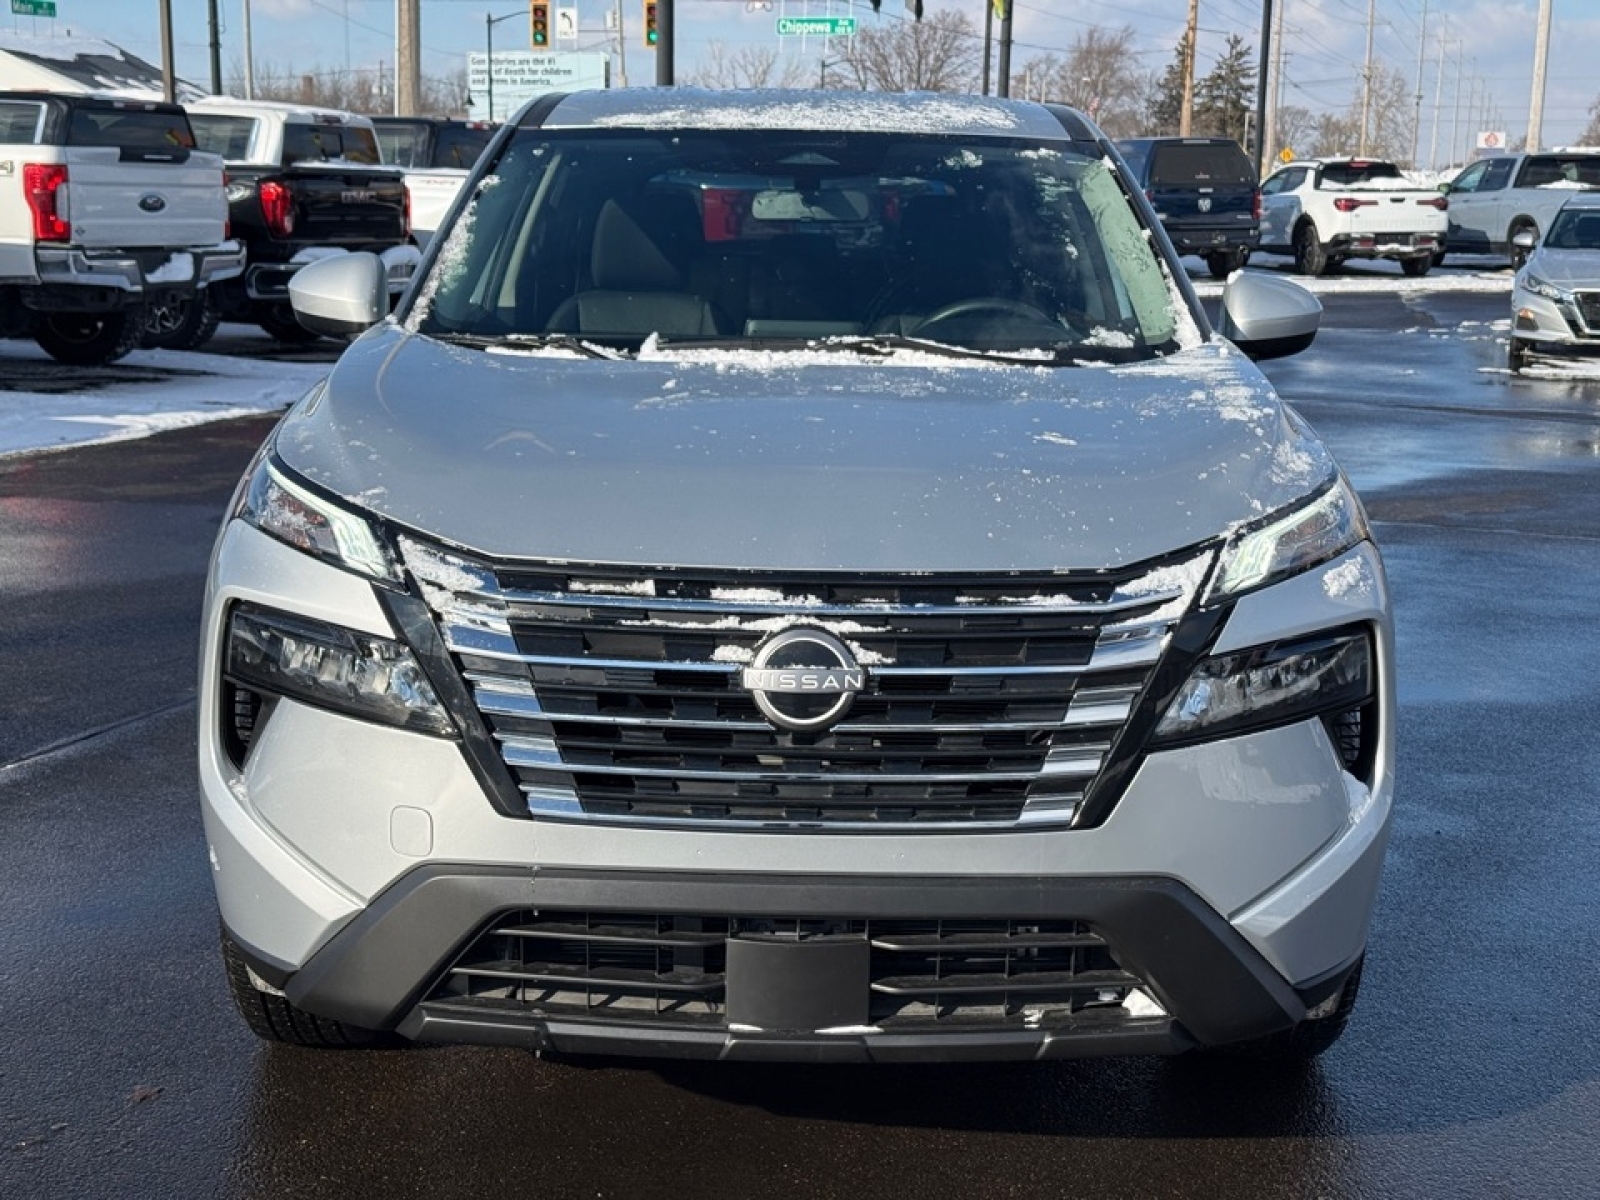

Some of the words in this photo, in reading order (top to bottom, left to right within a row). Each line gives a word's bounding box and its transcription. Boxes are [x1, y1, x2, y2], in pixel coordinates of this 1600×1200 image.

[13, 0, 34, 14] Main
[780, 19, 830, 35] Chippewa
[490, 57, 516, 67] njuries
[532, 57, 545, 66] the
[471, 68, 491, 76] caus
[494, 67, 503, 76] of
[504, 67, 525, 76] death
[527, 67, 539, 76] for
[541, 67, 573, 76] children
[471, 77, 486, 86] and
[489, 77, 509, 86] eens
[746, 674, 862, 689] NISSAN
